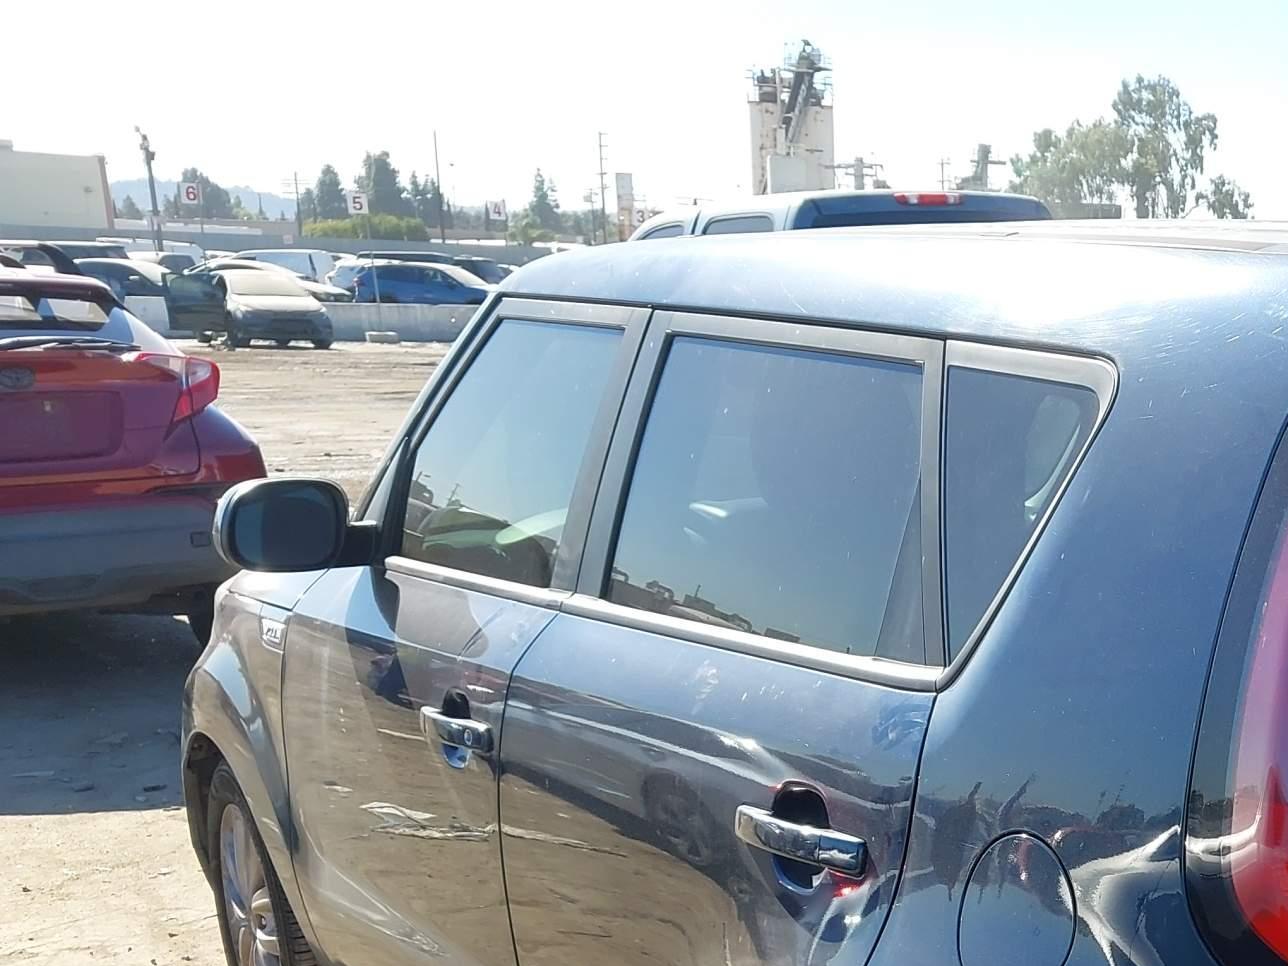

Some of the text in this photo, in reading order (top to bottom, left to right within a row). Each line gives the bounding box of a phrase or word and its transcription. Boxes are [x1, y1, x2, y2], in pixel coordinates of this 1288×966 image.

[185, 185, 197, 201] 6
[352, 196, 364, 211] 5
[492, 201, 503, 217] 4
[636, 209, 646, 223] 3
